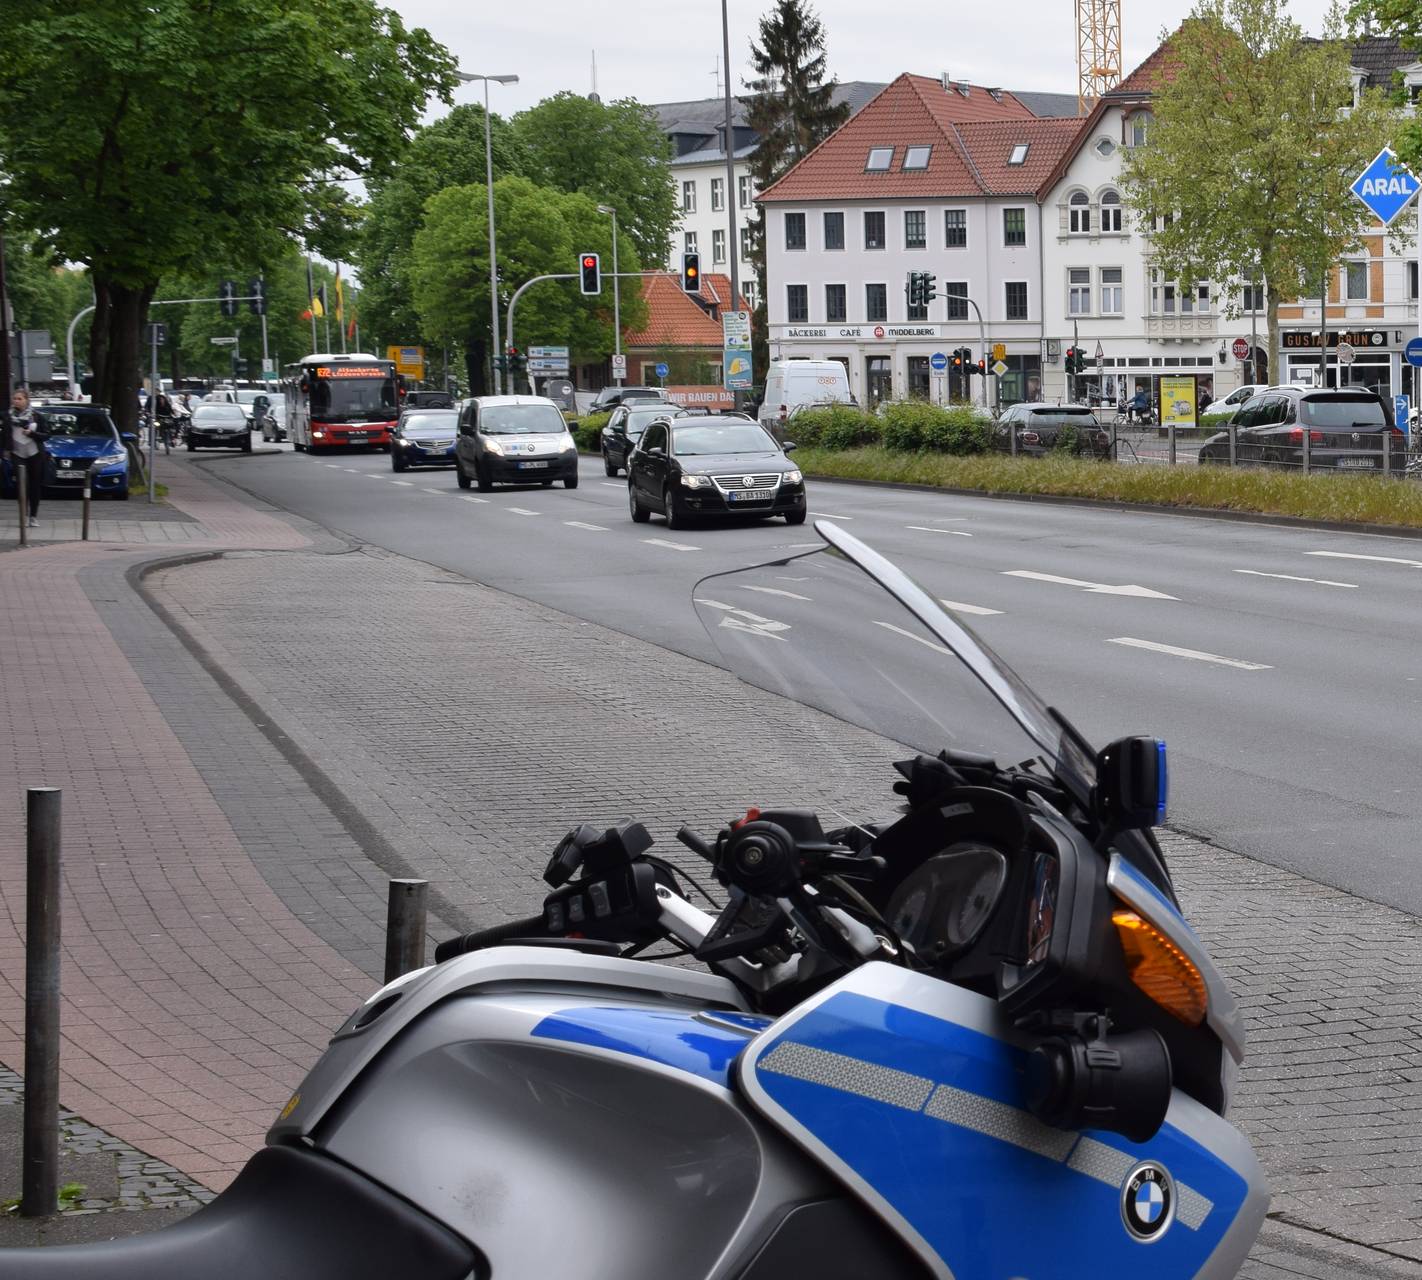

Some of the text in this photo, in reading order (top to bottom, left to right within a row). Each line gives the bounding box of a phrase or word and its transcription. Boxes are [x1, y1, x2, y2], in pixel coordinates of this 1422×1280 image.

[1361, 177, 1413, 197] ARAL
[788, 327, 935, 337] BÄCKEREI CAFÉ MIDDELBERG
[1287, 333, 1368, 346] GUSTAV GRÜN
[1233, 344, 1248, 353] STOP
[671, 392, 686, 402] WIR
[688, 392, 718, 402] BAUEN
[1131, 1170, 1168, 1191] BMW
